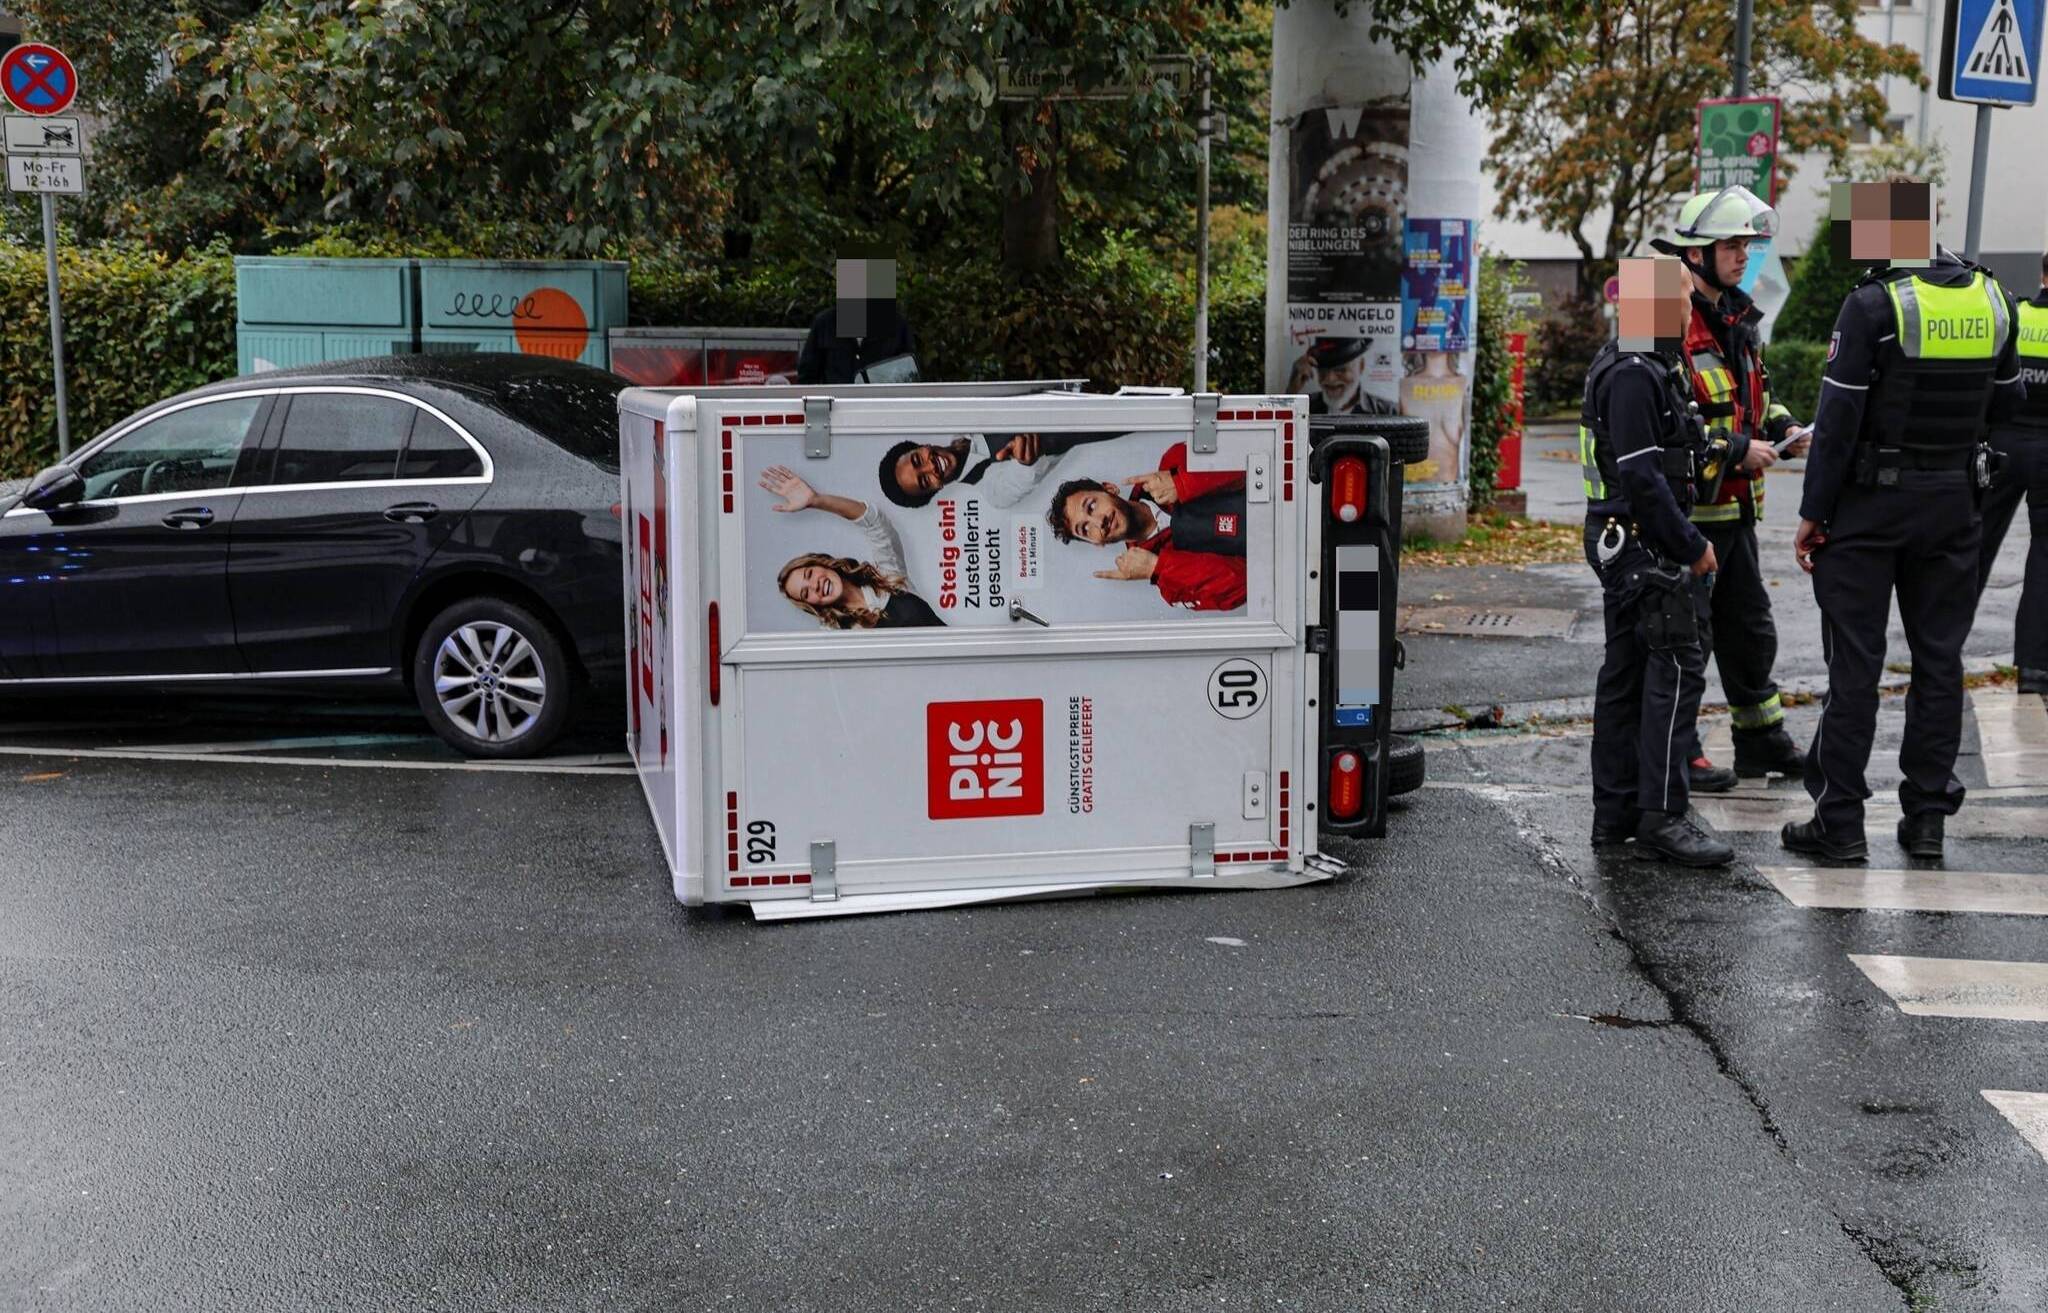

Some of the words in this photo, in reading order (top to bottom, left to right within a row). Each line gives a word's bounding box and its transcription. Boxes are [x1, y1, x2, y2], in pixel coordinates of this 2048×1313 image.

[23, 161, 66, 172] Mo-Fr
[1289, 228, 1308, 239] DER
[1310, 228, 1338, 239] RING
[1341, 227, 1367, 239] DES
[1289, 239, 1360, 250] NIBELUNGEN
[1289, 308, 1316, 321] NINO
[1318, 308, 1334, 320] DE
[1338, 307, 1395, 321] ANGELO
[1367, 325, 1395, 334] BAND
[1928, 317, 1989, 340] POLIZEI
[937, 500, 956, 541] ein!
[1018, 526, 1027, 546] dich
[964, 499, 980, 608] Zusteller:in
[1029, 526, 1037, 558] Minute
[939, 547, 960, 609] Steig
[985, 528, 1004, 607] gesucht
[1019, 547, 1028, 578] Bewirb
[1029, 567, 1037, 577] in
[1218, 669, 1258, 708] 50
[1069, 696, 1080, 738] PREISE
[1082, 696, 1093, 764] GELIEFERT
[1356, 712, 1365, 721] D
[948, 719, 985, 801] PIC
[1067, 739, 1080, 814] GÜNSTIGSTE
[1082, 767, 1093, 814] GRATIS
[746, 820, 776, 864] 929
